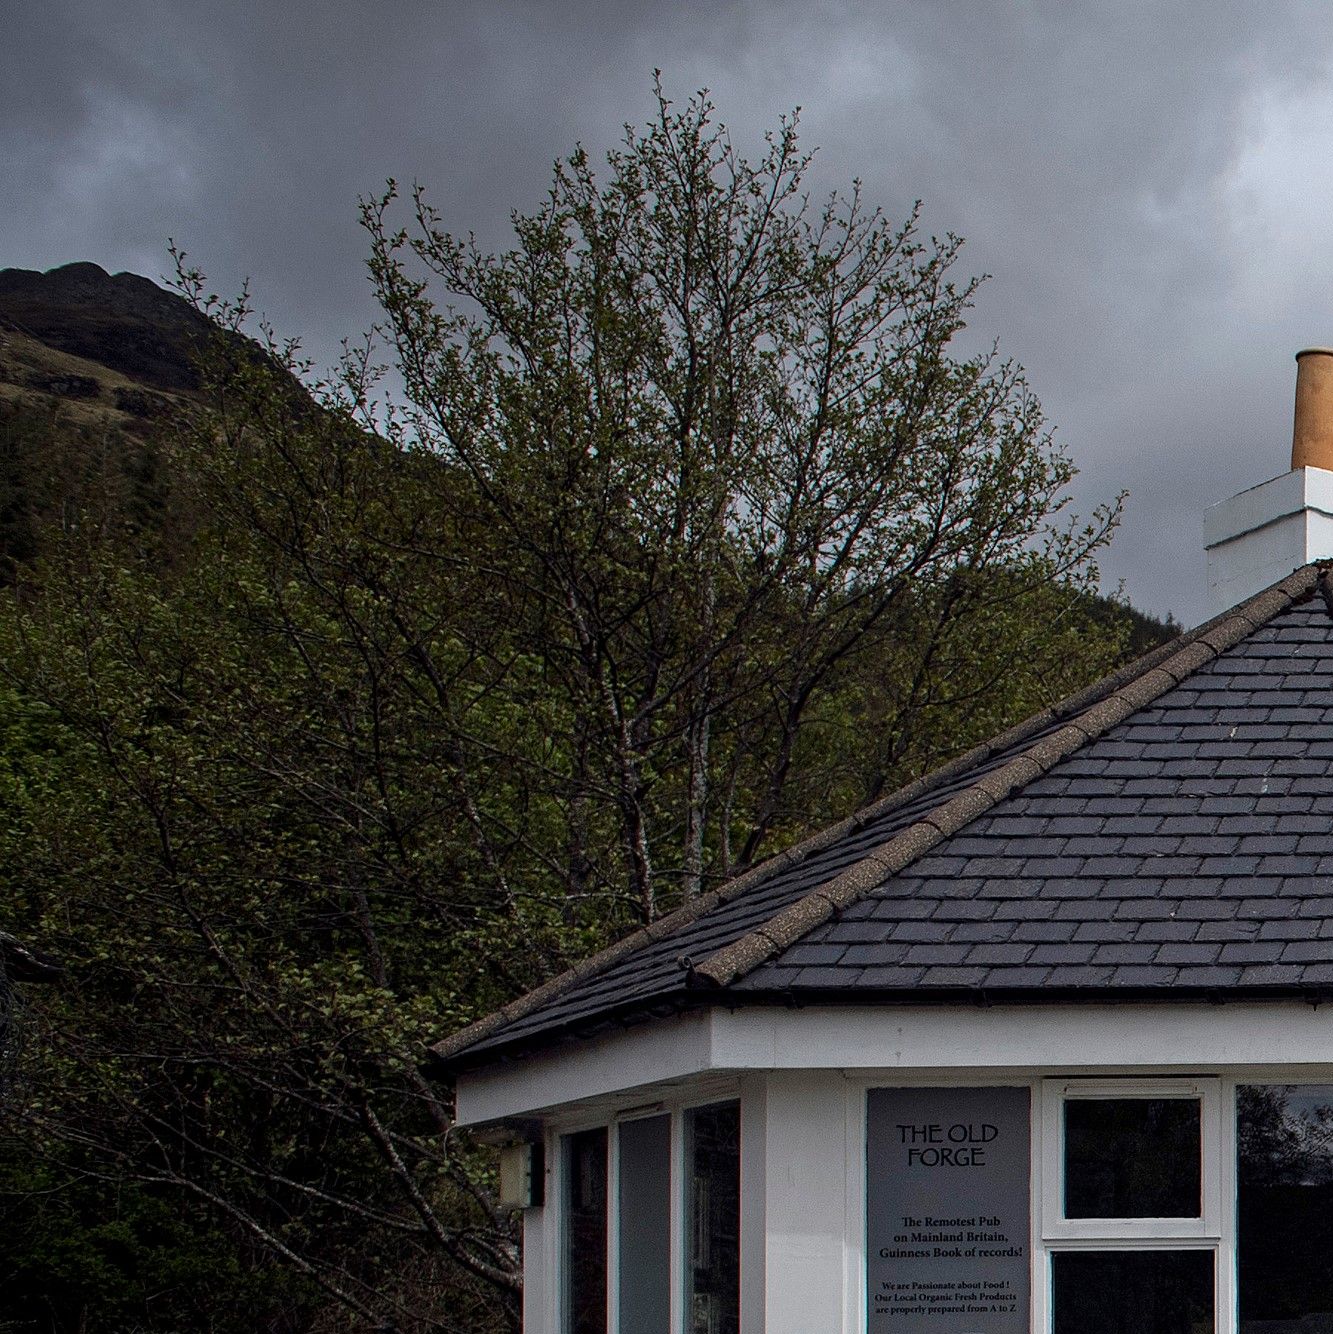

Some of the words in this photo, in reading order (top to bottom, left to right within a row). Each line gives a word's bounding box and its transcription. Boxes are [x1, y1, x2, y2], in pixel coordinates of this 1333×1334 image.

[896, 1124, 943, 1143] THE
[948, 1124, 998, 1143] OLD
[908, 1148, 985, 1166] FORGE
[902, 1217, 922, 1226] The
[925, 1217, 976, 1226] Remotest
[979, 1216, 1000, 1226] Pub
[911, 1232, 963, 1242] Mainland
[967, 1232, 1008, 1242] Britain,
[880, 1248, 930, 1258] Guinness
[934, 1248, 962, 1258] Book
[965, 1247, 976, 1257] of
[979, 1247, 1022, 1257] records!
[882, 1282, 895, 1290] We
[912, 1282, 955, 1290] Passionate
[958, 1281, 981, 1289] about
[919, 1293, 952, 1303] Organic
[891, 1305, 925, 1315] properly
[928, 1305, 965, 1315] prepared
